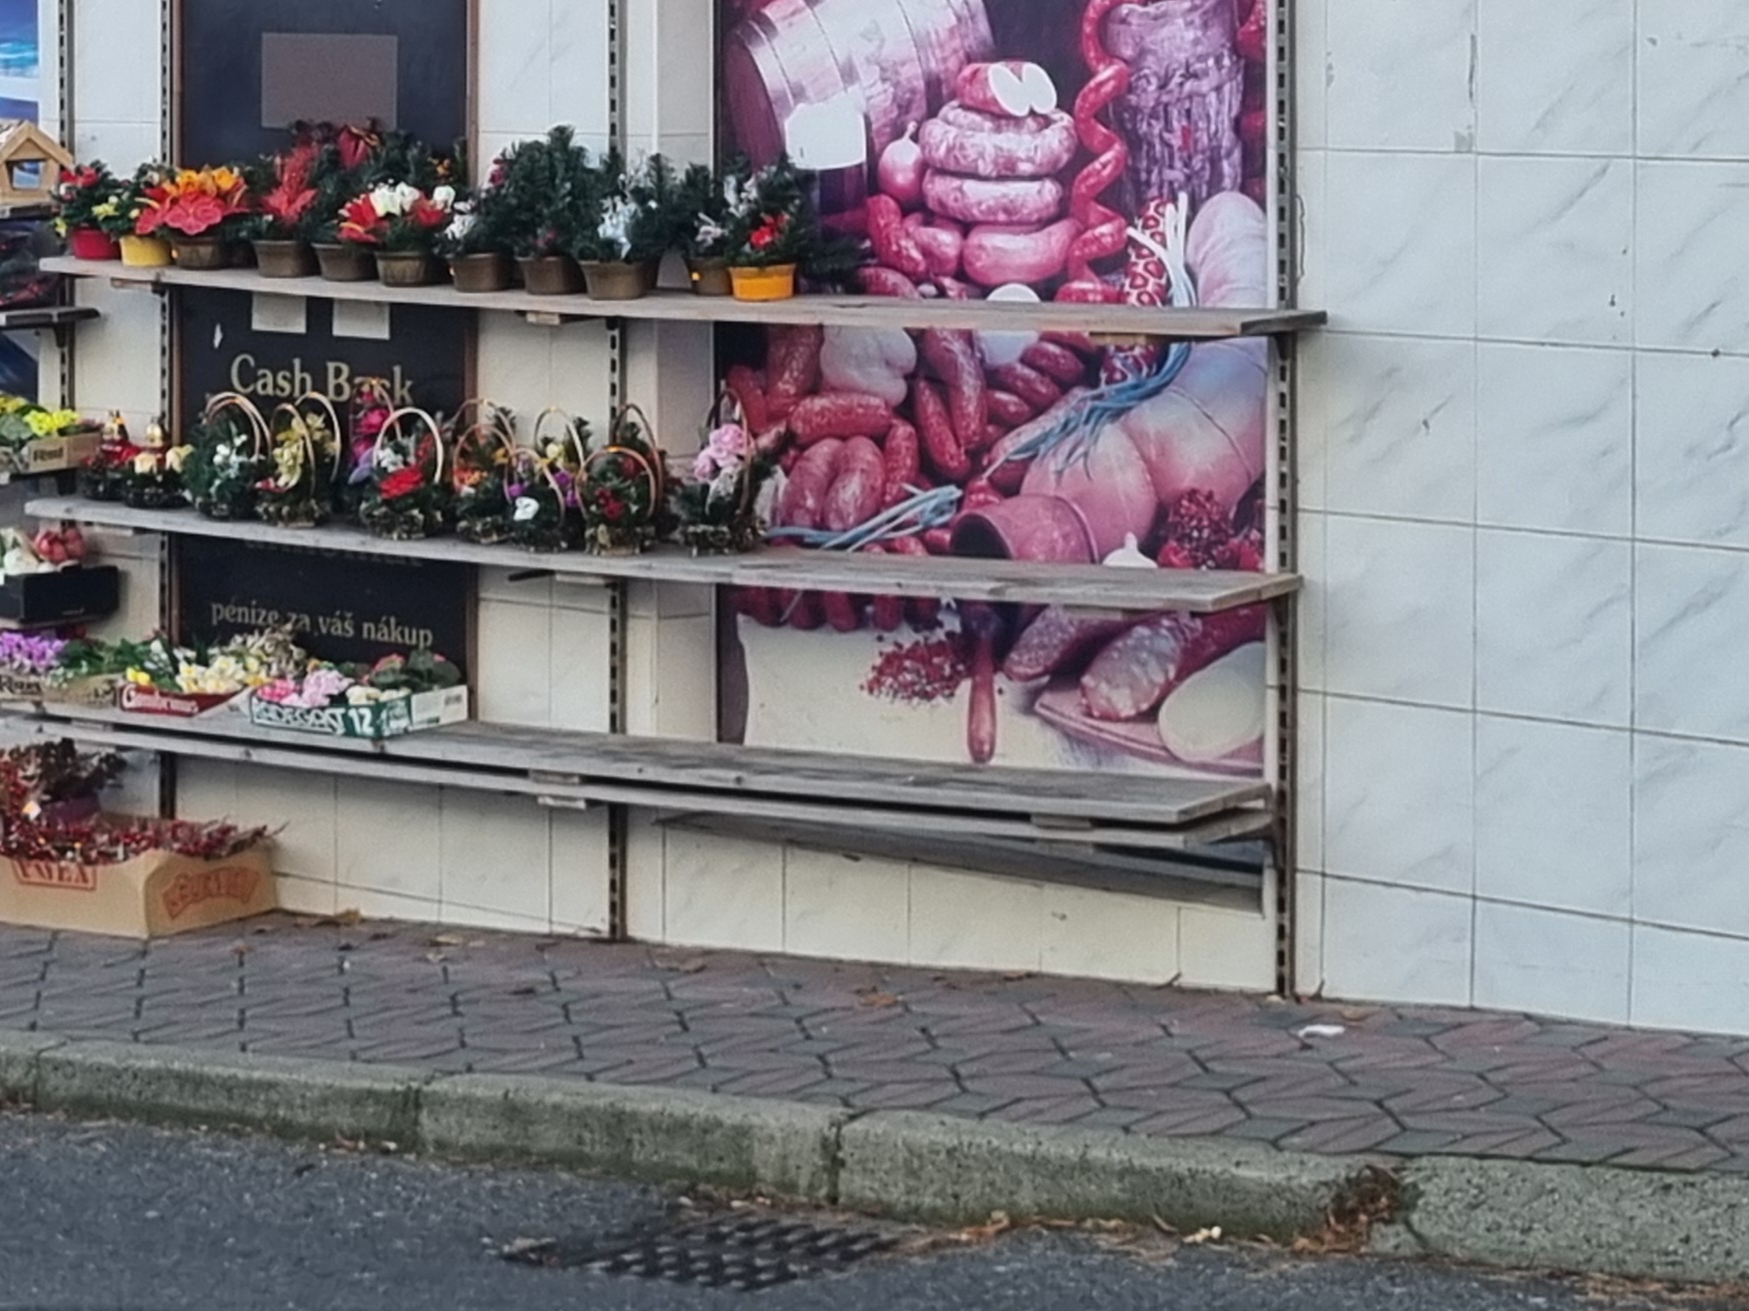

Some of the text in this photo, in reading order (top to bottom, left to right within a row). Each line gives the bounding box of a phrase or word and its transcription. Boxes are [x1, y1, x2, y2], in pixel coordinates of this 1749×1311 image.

[230, 353, 313, 398] Cash
[211, 599, 280, 627] peníze
[318, 609, 355, 638] váš
[362, 614, 434, 650] nákup
[348, 707, 374, 736] 12
